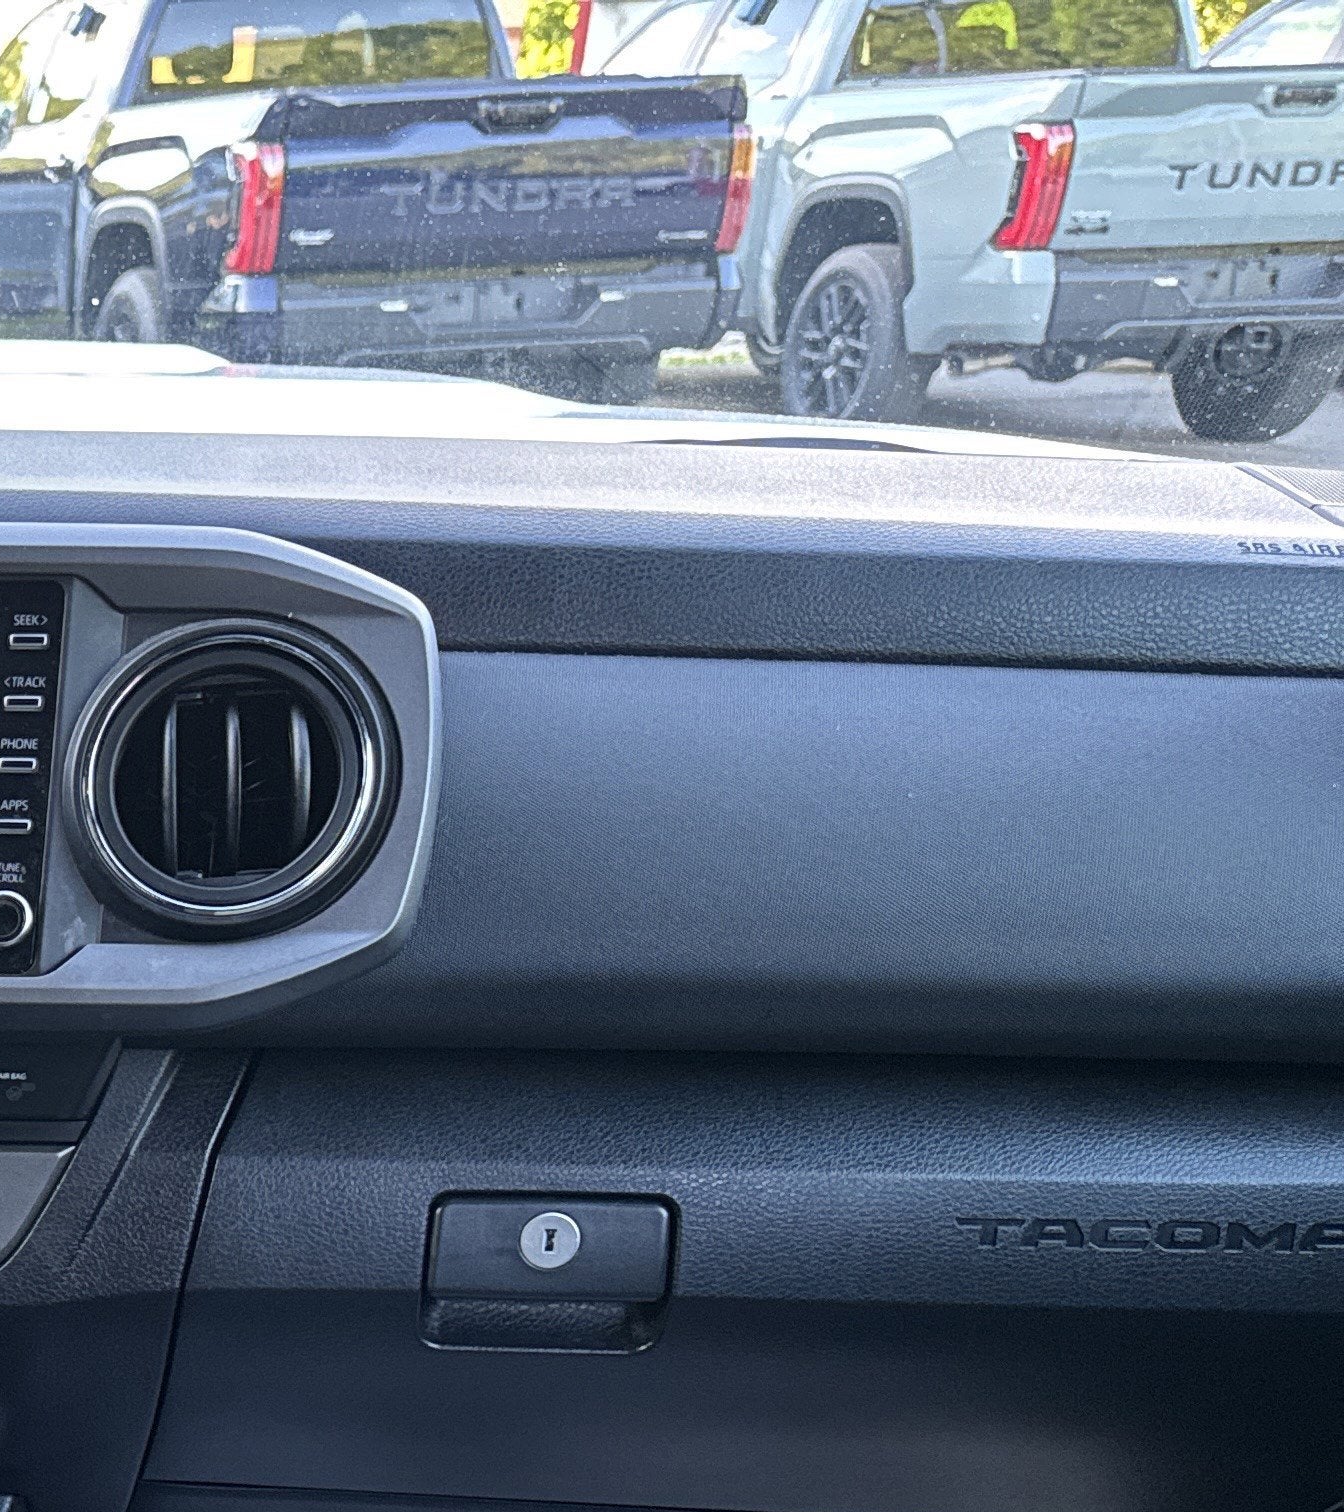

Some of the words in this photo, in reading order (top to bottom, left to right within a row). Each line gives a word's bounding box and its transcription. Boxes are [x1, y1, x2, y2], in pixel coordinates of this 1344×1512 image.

[380, 174, 636, 216] TUNDRA
[13, 614, 39, 626] SEEK
[11, 676, 46, 689] TRACK
[0, 738, 39, 750] PHONE
[0, 800, 29, 812] APPS
